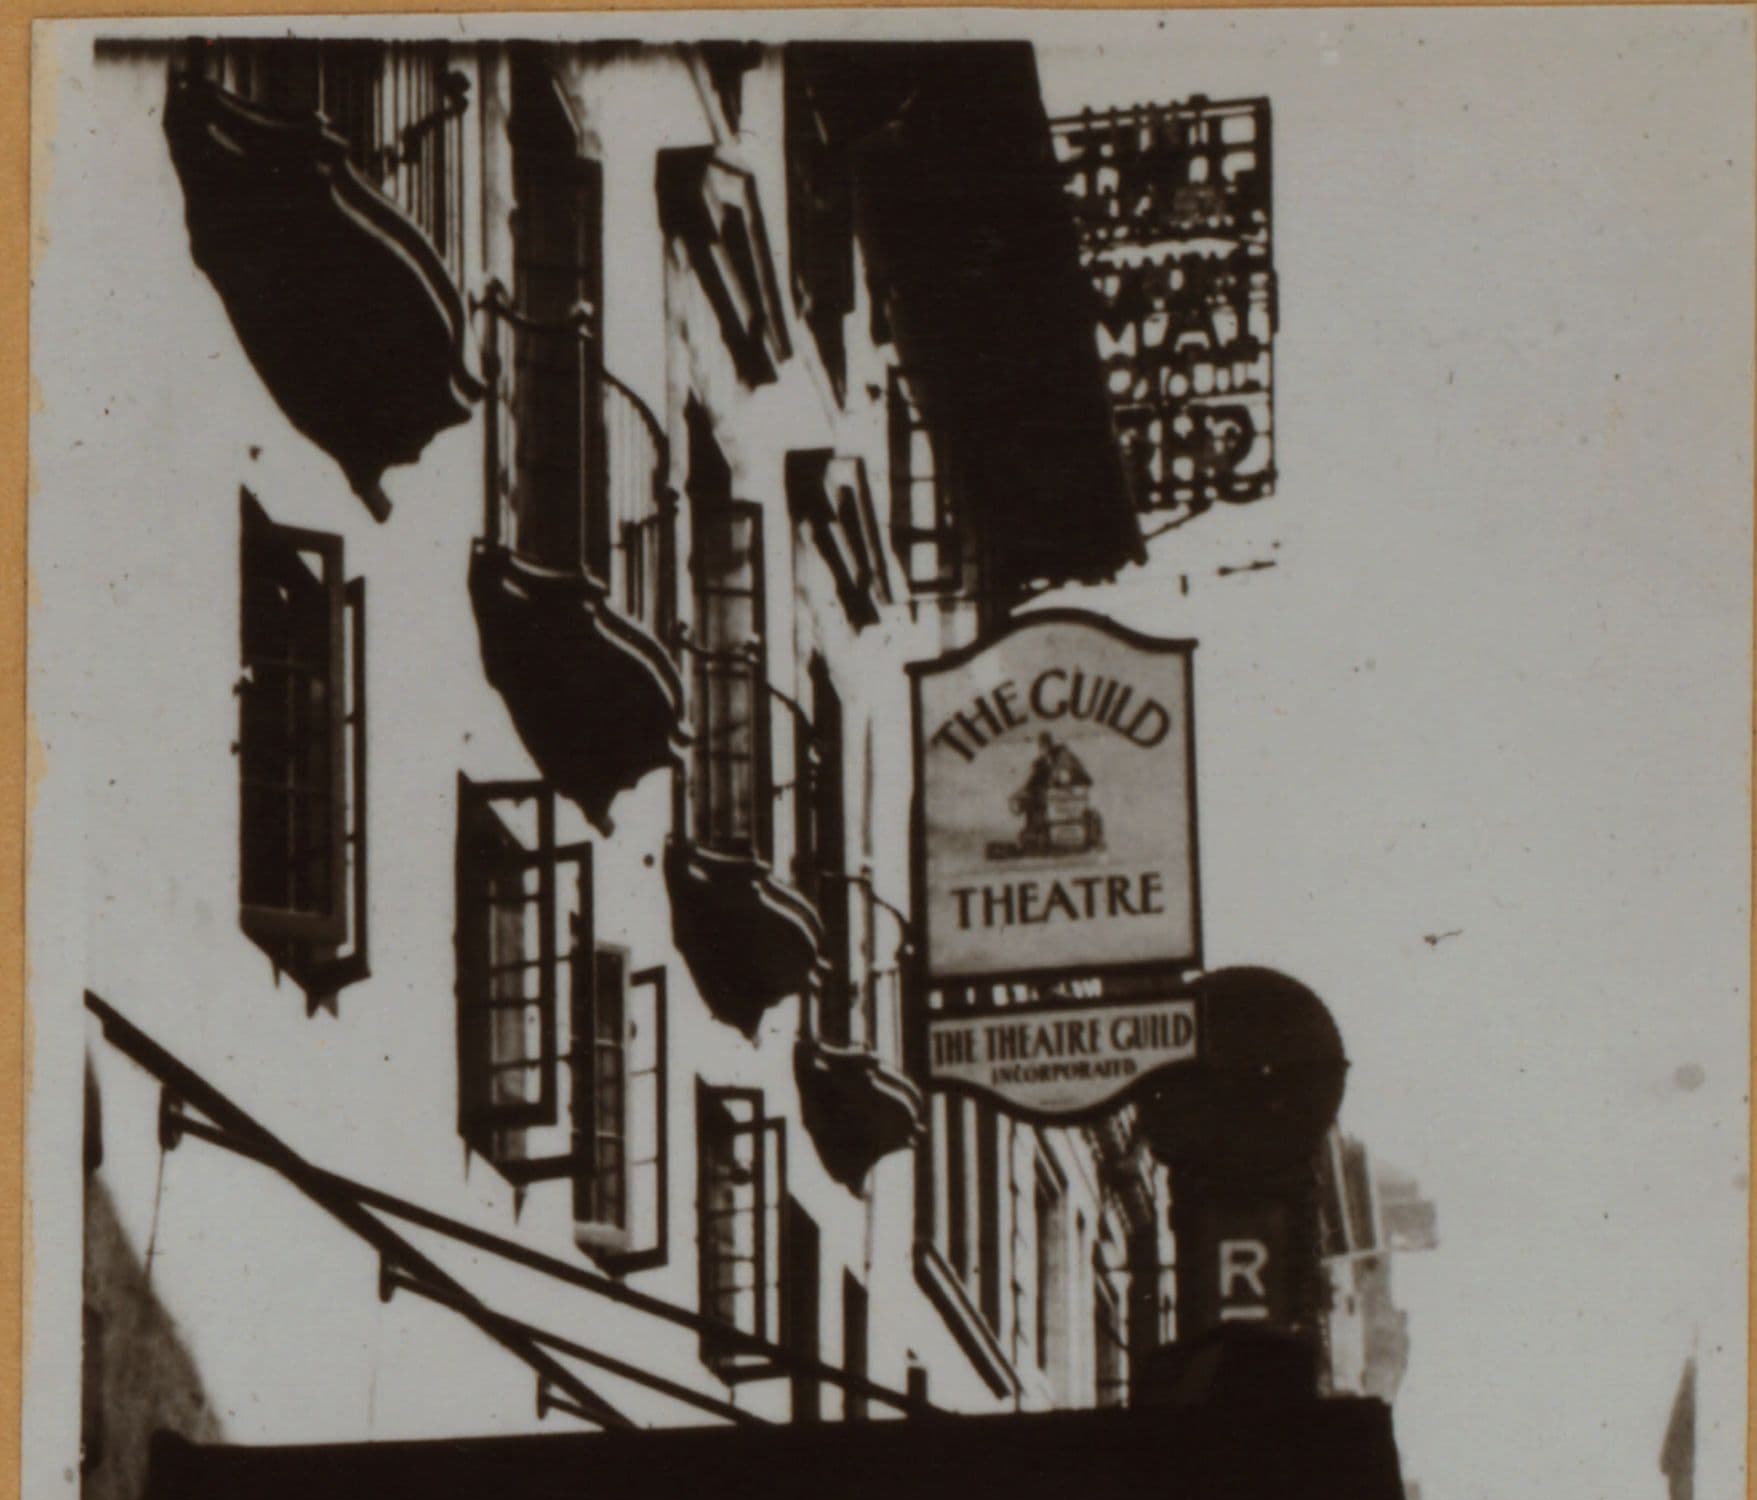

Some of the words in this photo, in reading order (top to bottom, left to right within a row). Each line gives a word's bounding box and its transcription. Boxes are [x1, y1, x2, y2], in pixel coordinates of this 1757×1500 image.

[932, 681, 1028, 762] THE
[1030, 667, 1170, 748] GUILD
[951, 871, 1164, 929] THEATRE
[933, 1028, 975, 1067] THE
[985, 1018, 1100, 1061] THEATRE
[1110, 1012, 1193, 1051] GUILD
[992, 1058, 1137, 1085] INCORPORATED
